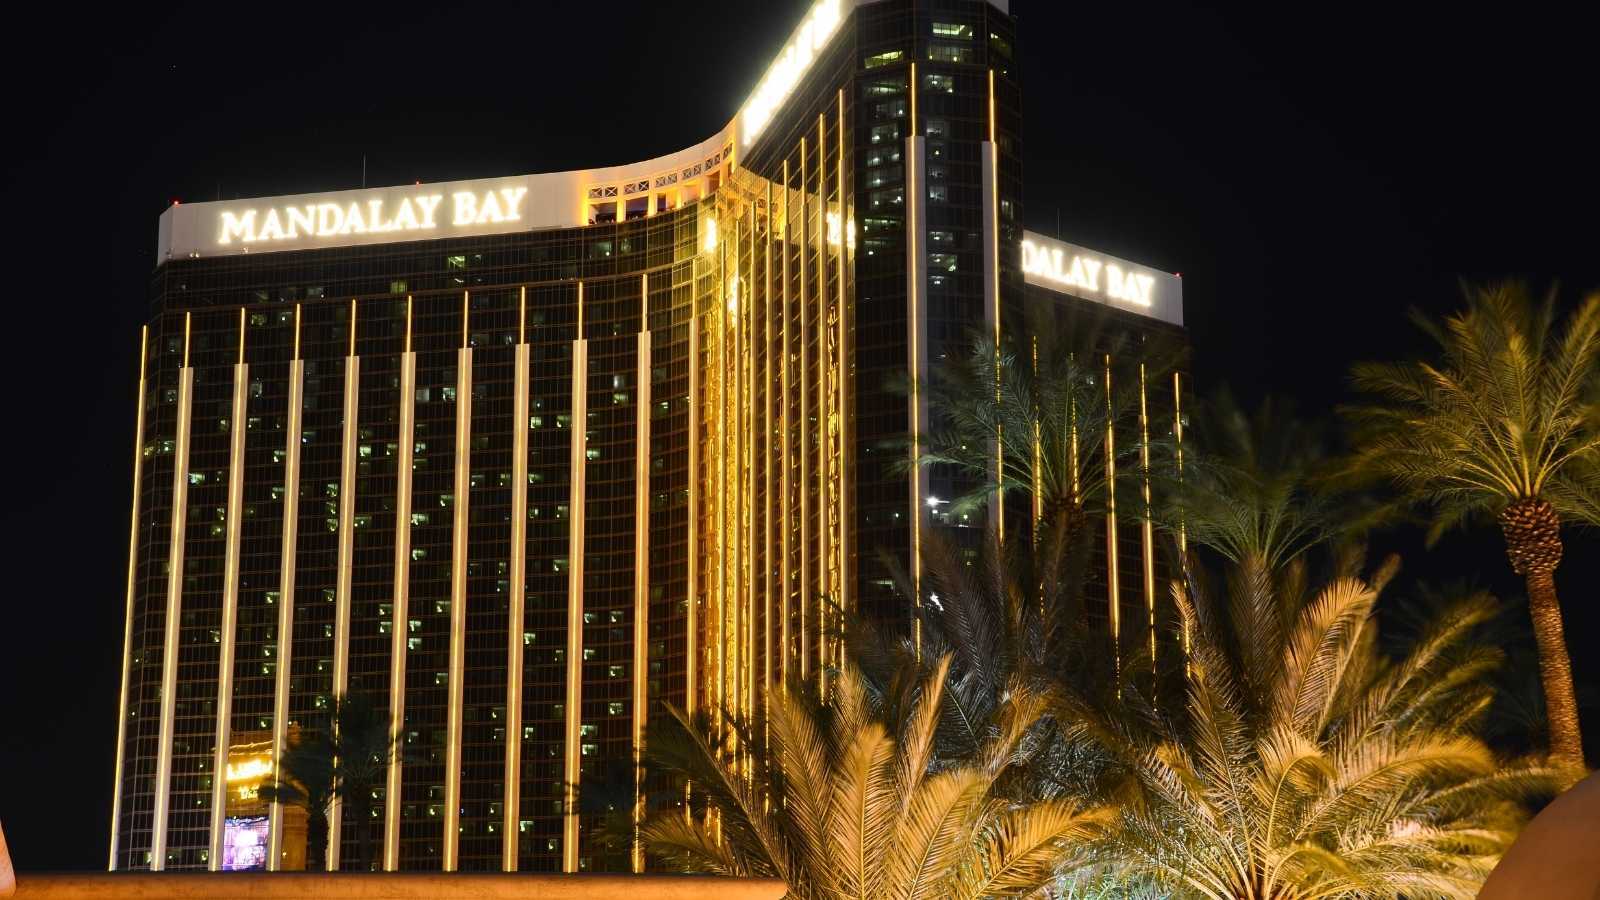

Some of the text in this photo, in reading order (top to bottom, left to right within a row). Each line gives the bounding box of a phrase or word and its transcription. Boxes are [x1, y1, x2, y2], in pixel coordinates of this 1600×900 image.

[218, 186, 528, 244] MANDALAY BAY
[1106, 264, 1155, 307] BAY
